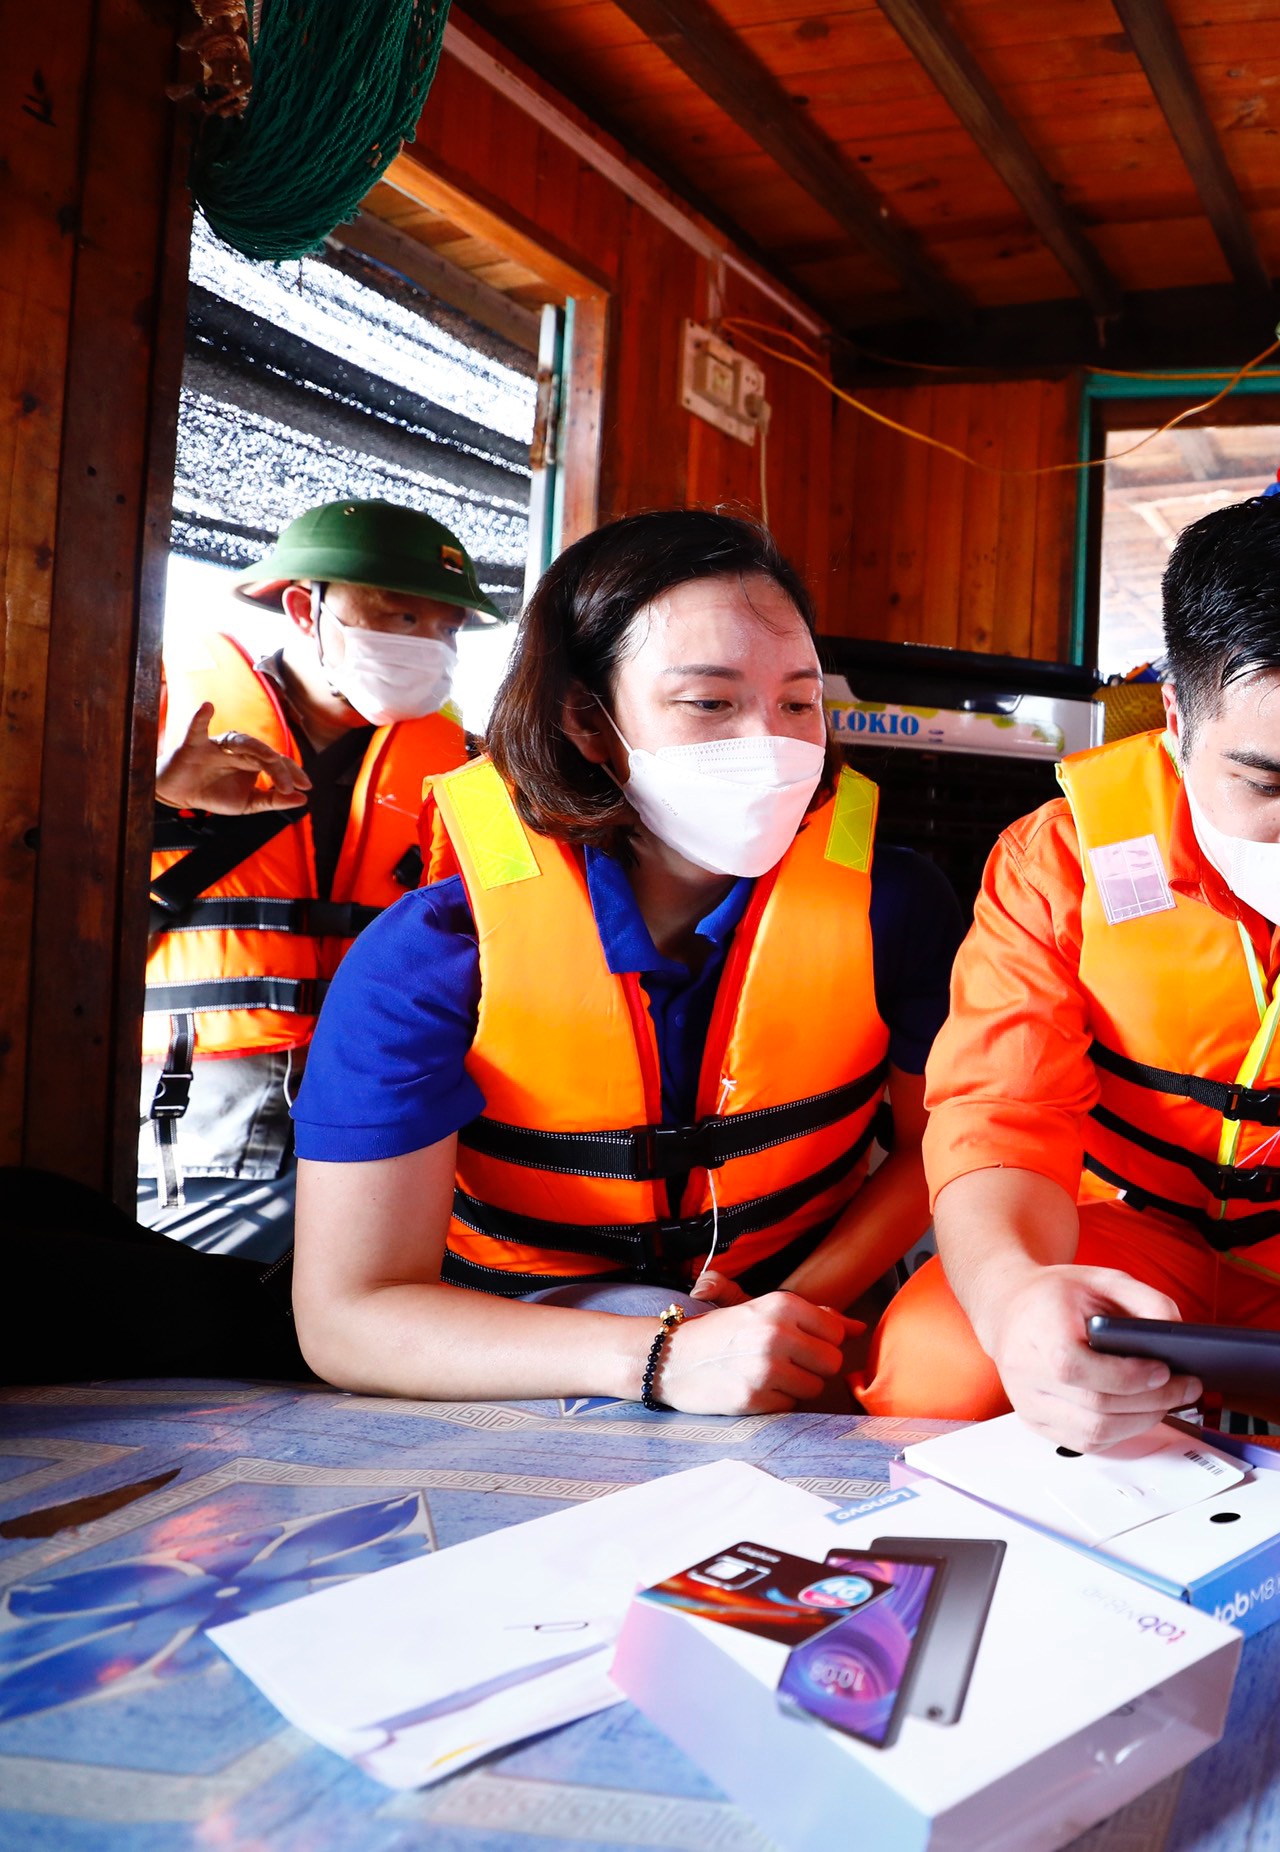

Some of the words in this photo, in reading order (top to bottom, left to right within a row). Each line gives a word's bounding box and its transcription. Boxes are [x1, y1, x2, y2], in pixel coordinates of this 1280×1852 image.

[832, 709, 919, 736] LOKIO
[836, 1491, 911, 1520] Lenovo
[1136, 1615, 1187, 1645] tab
